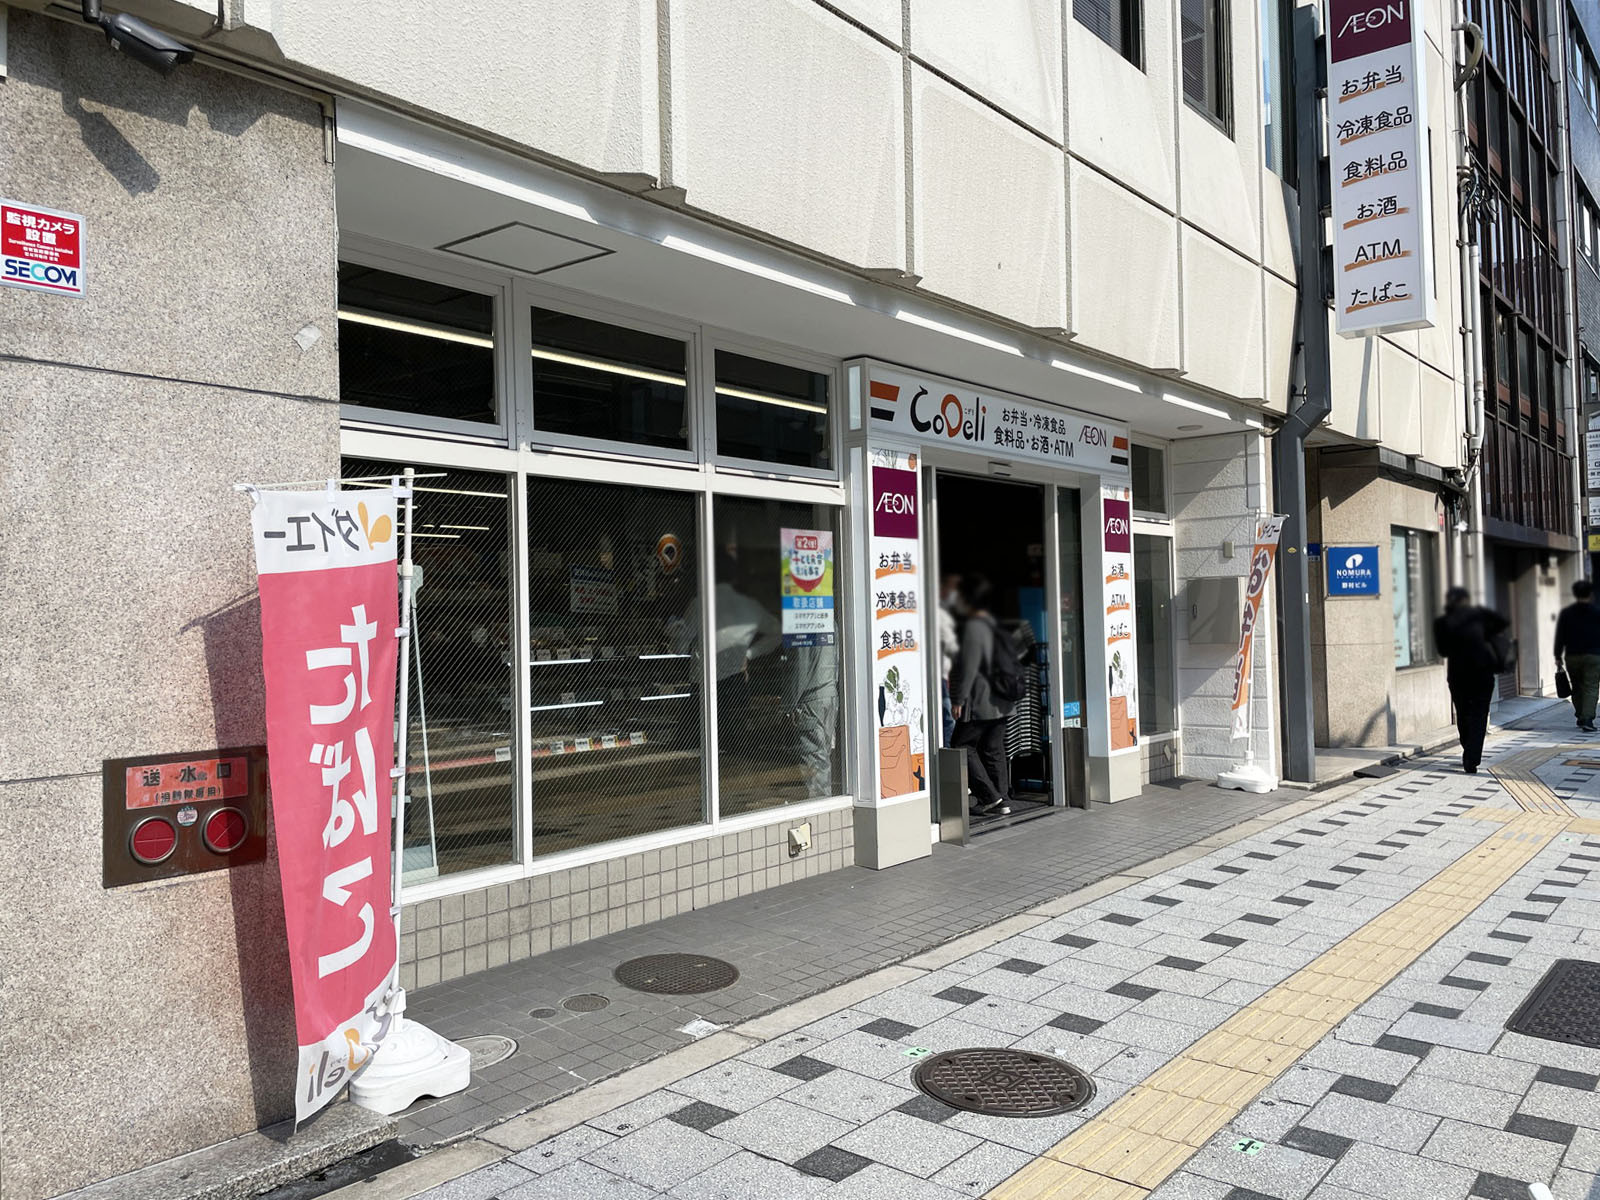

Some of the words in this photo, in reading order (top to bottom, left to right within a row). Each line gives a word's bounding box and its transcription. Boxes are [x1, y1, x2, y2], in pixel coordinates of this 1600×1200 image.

[1342, 65, 1402, 95] お弁当
[1337, 106, 1412, 139] 冷凍食品
[1343, 151, 1408, 182] 食料品
[1357, 196, 1397, 219] お酒
[6, 211, 75, 235] 監視カメラ
[25, 228, 57, 245] 設置
[1355, 238, 1401, 263] ATM
[5, 259, 77, 286] SECOM
[1351, 282, 1408, 306] たばこ
[879, 551, 912, 571] お弁当
[1111, 563, 1125, 578] お酒
[876, 590, 917, 610] 冷凍食品
[1111, 594, 1126, 608] ATM
[880, 629, 915, 650] 食料品
